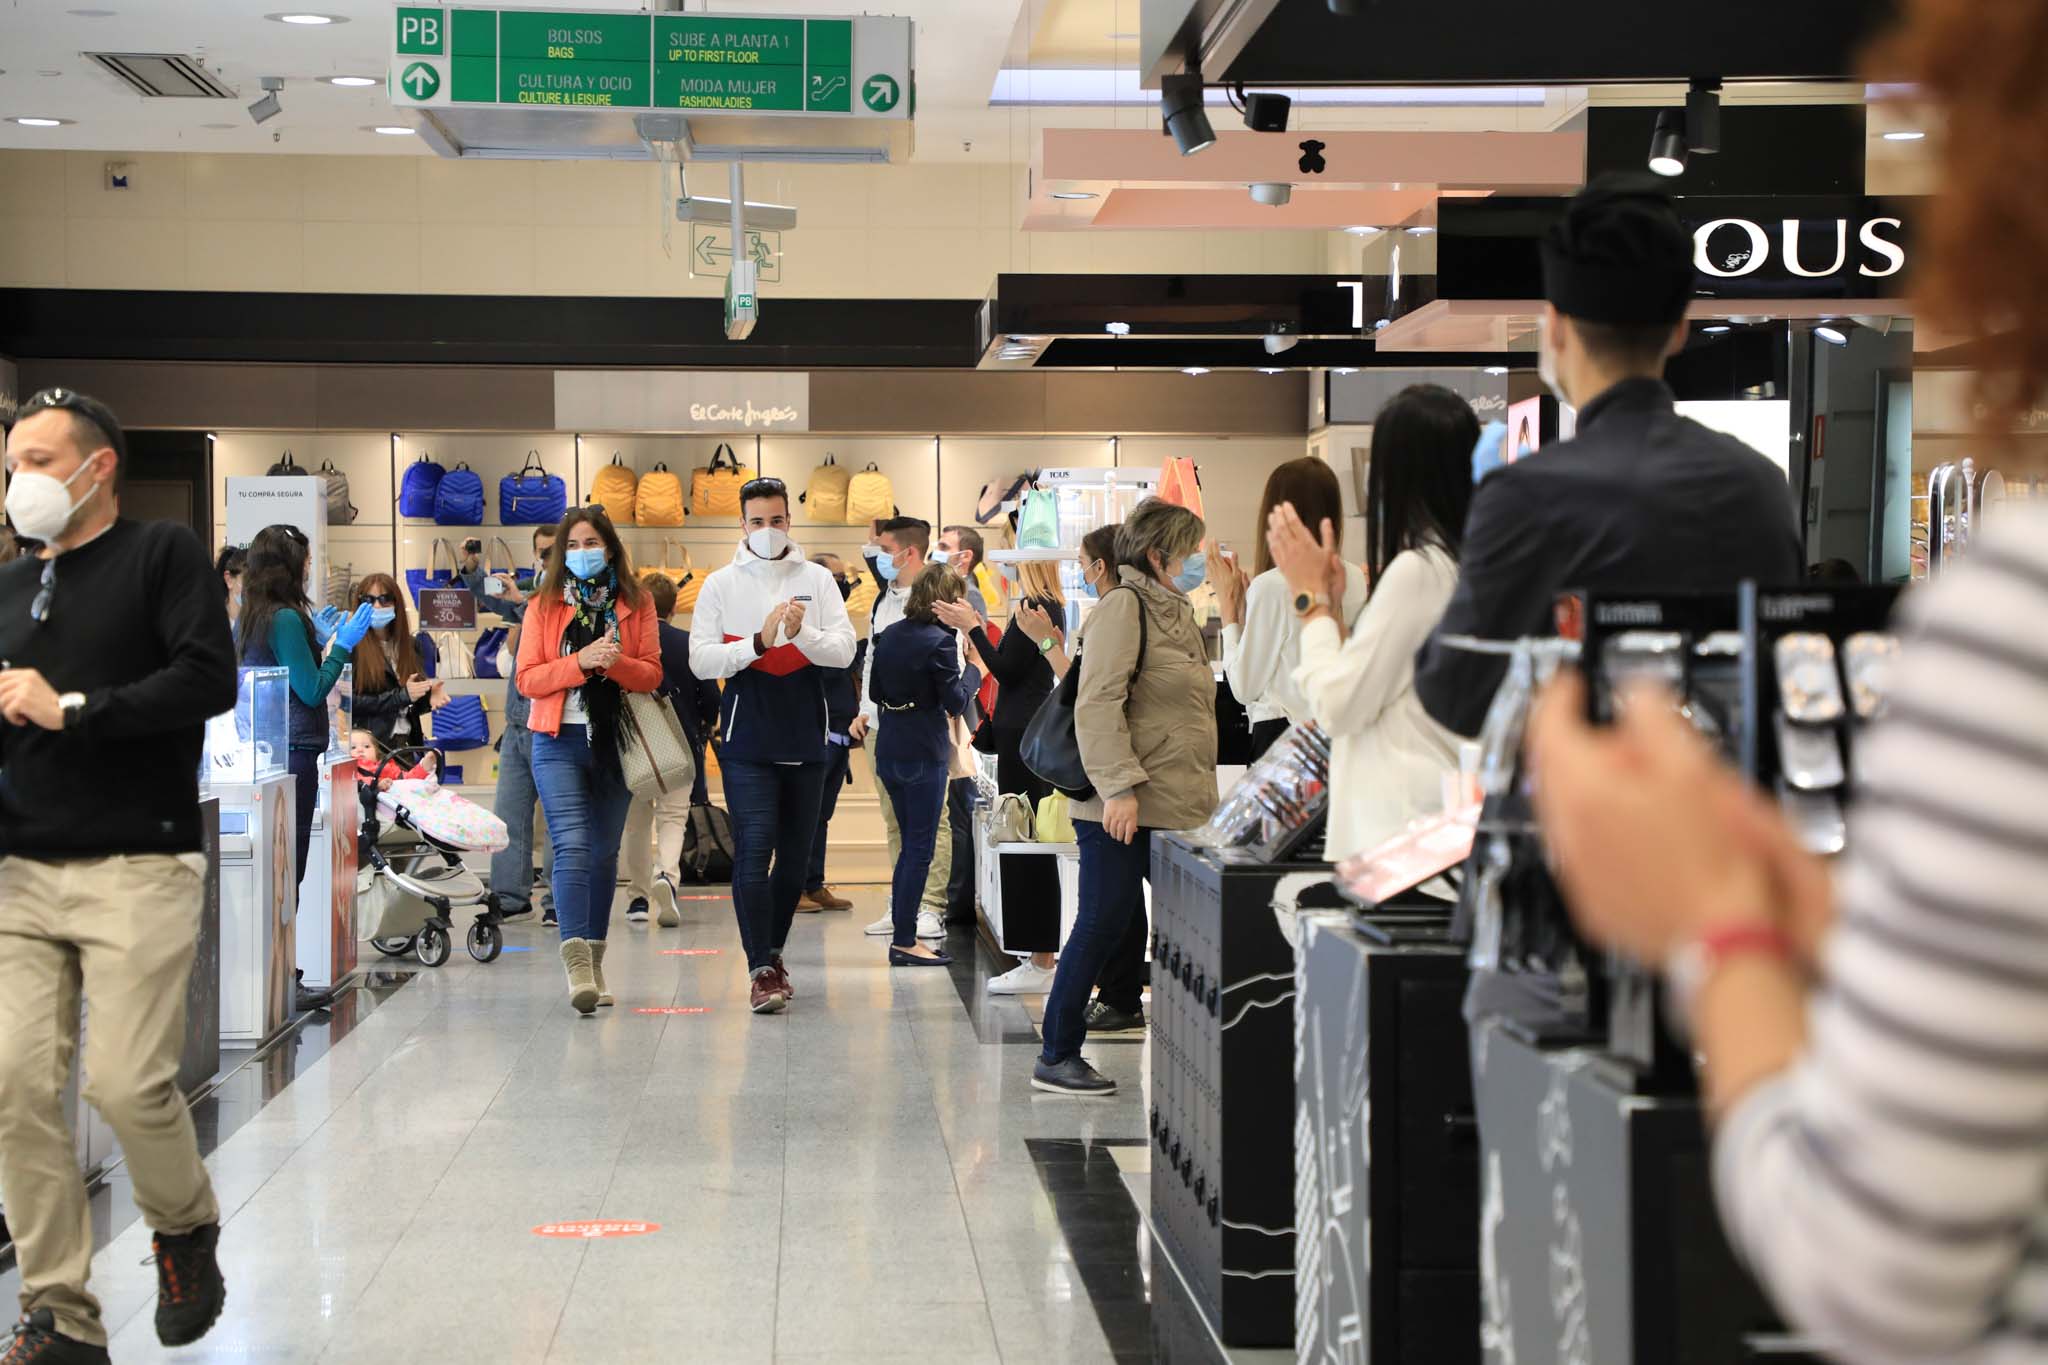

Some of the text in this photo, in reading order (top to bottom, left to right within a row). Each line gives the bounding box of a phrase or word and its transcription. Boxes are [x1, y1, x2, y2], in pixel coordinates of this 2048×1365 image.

[402, 17, 438, 45] PB
[549, 29, 602, 44] BOLSOS
[670, 32, 789, 49] SUBE A PLANTA 1
[548, 47, 574, 58] BAGS
[669, 49, 759, 63] UP TO FIRST FLOOR
[518, 73, 632, 91] CULTURA Y OCIO
[681, 79, 776, 95] MODA MUJER
[518, 91, 611, 106] CULTURE & LEISURE
[1692, 218, 1905, 277] OUS
[739, 296, 752, 307] PB
[690, 400, 798, 427] El Corte Inglés
